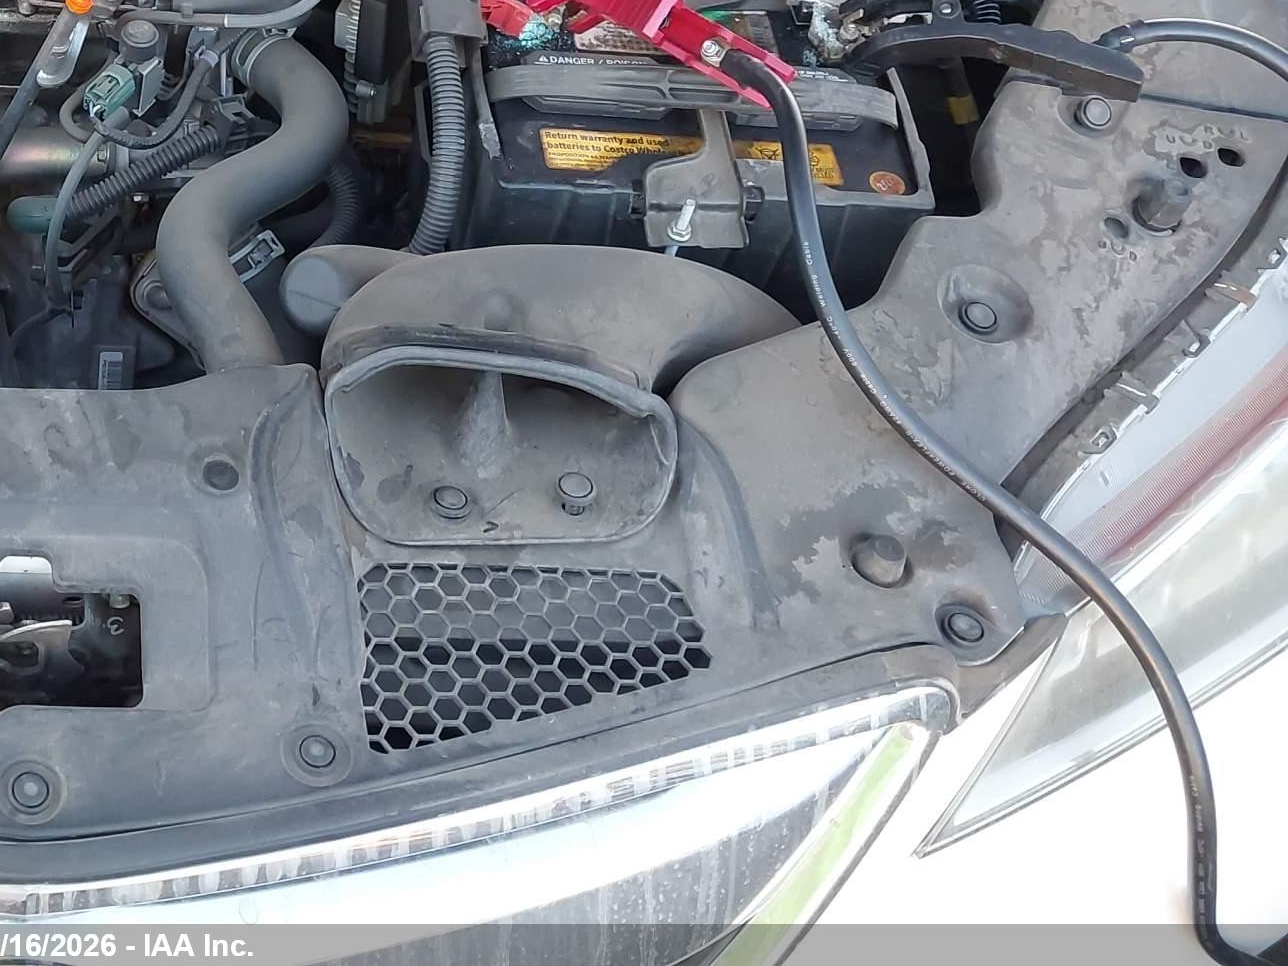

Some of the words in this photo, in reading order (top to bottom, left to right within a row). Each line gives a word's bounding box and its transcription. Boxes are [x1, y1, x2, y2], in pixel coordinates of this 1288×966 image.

[550, 55, 594, 65] DANGER
[544, 130, 579, 141] Return
[580, 134, 624, 146] warranty
[626, 136, 645, 146] and
[646, 138, 670, 147] used
[546, 141, 591, 152] batteries
[592, 143, 601, 153] to
[603, 145, 635, 155] Costco
[803, 241, 813, 266] Cable
[811, 274, 827, 307] Welding
